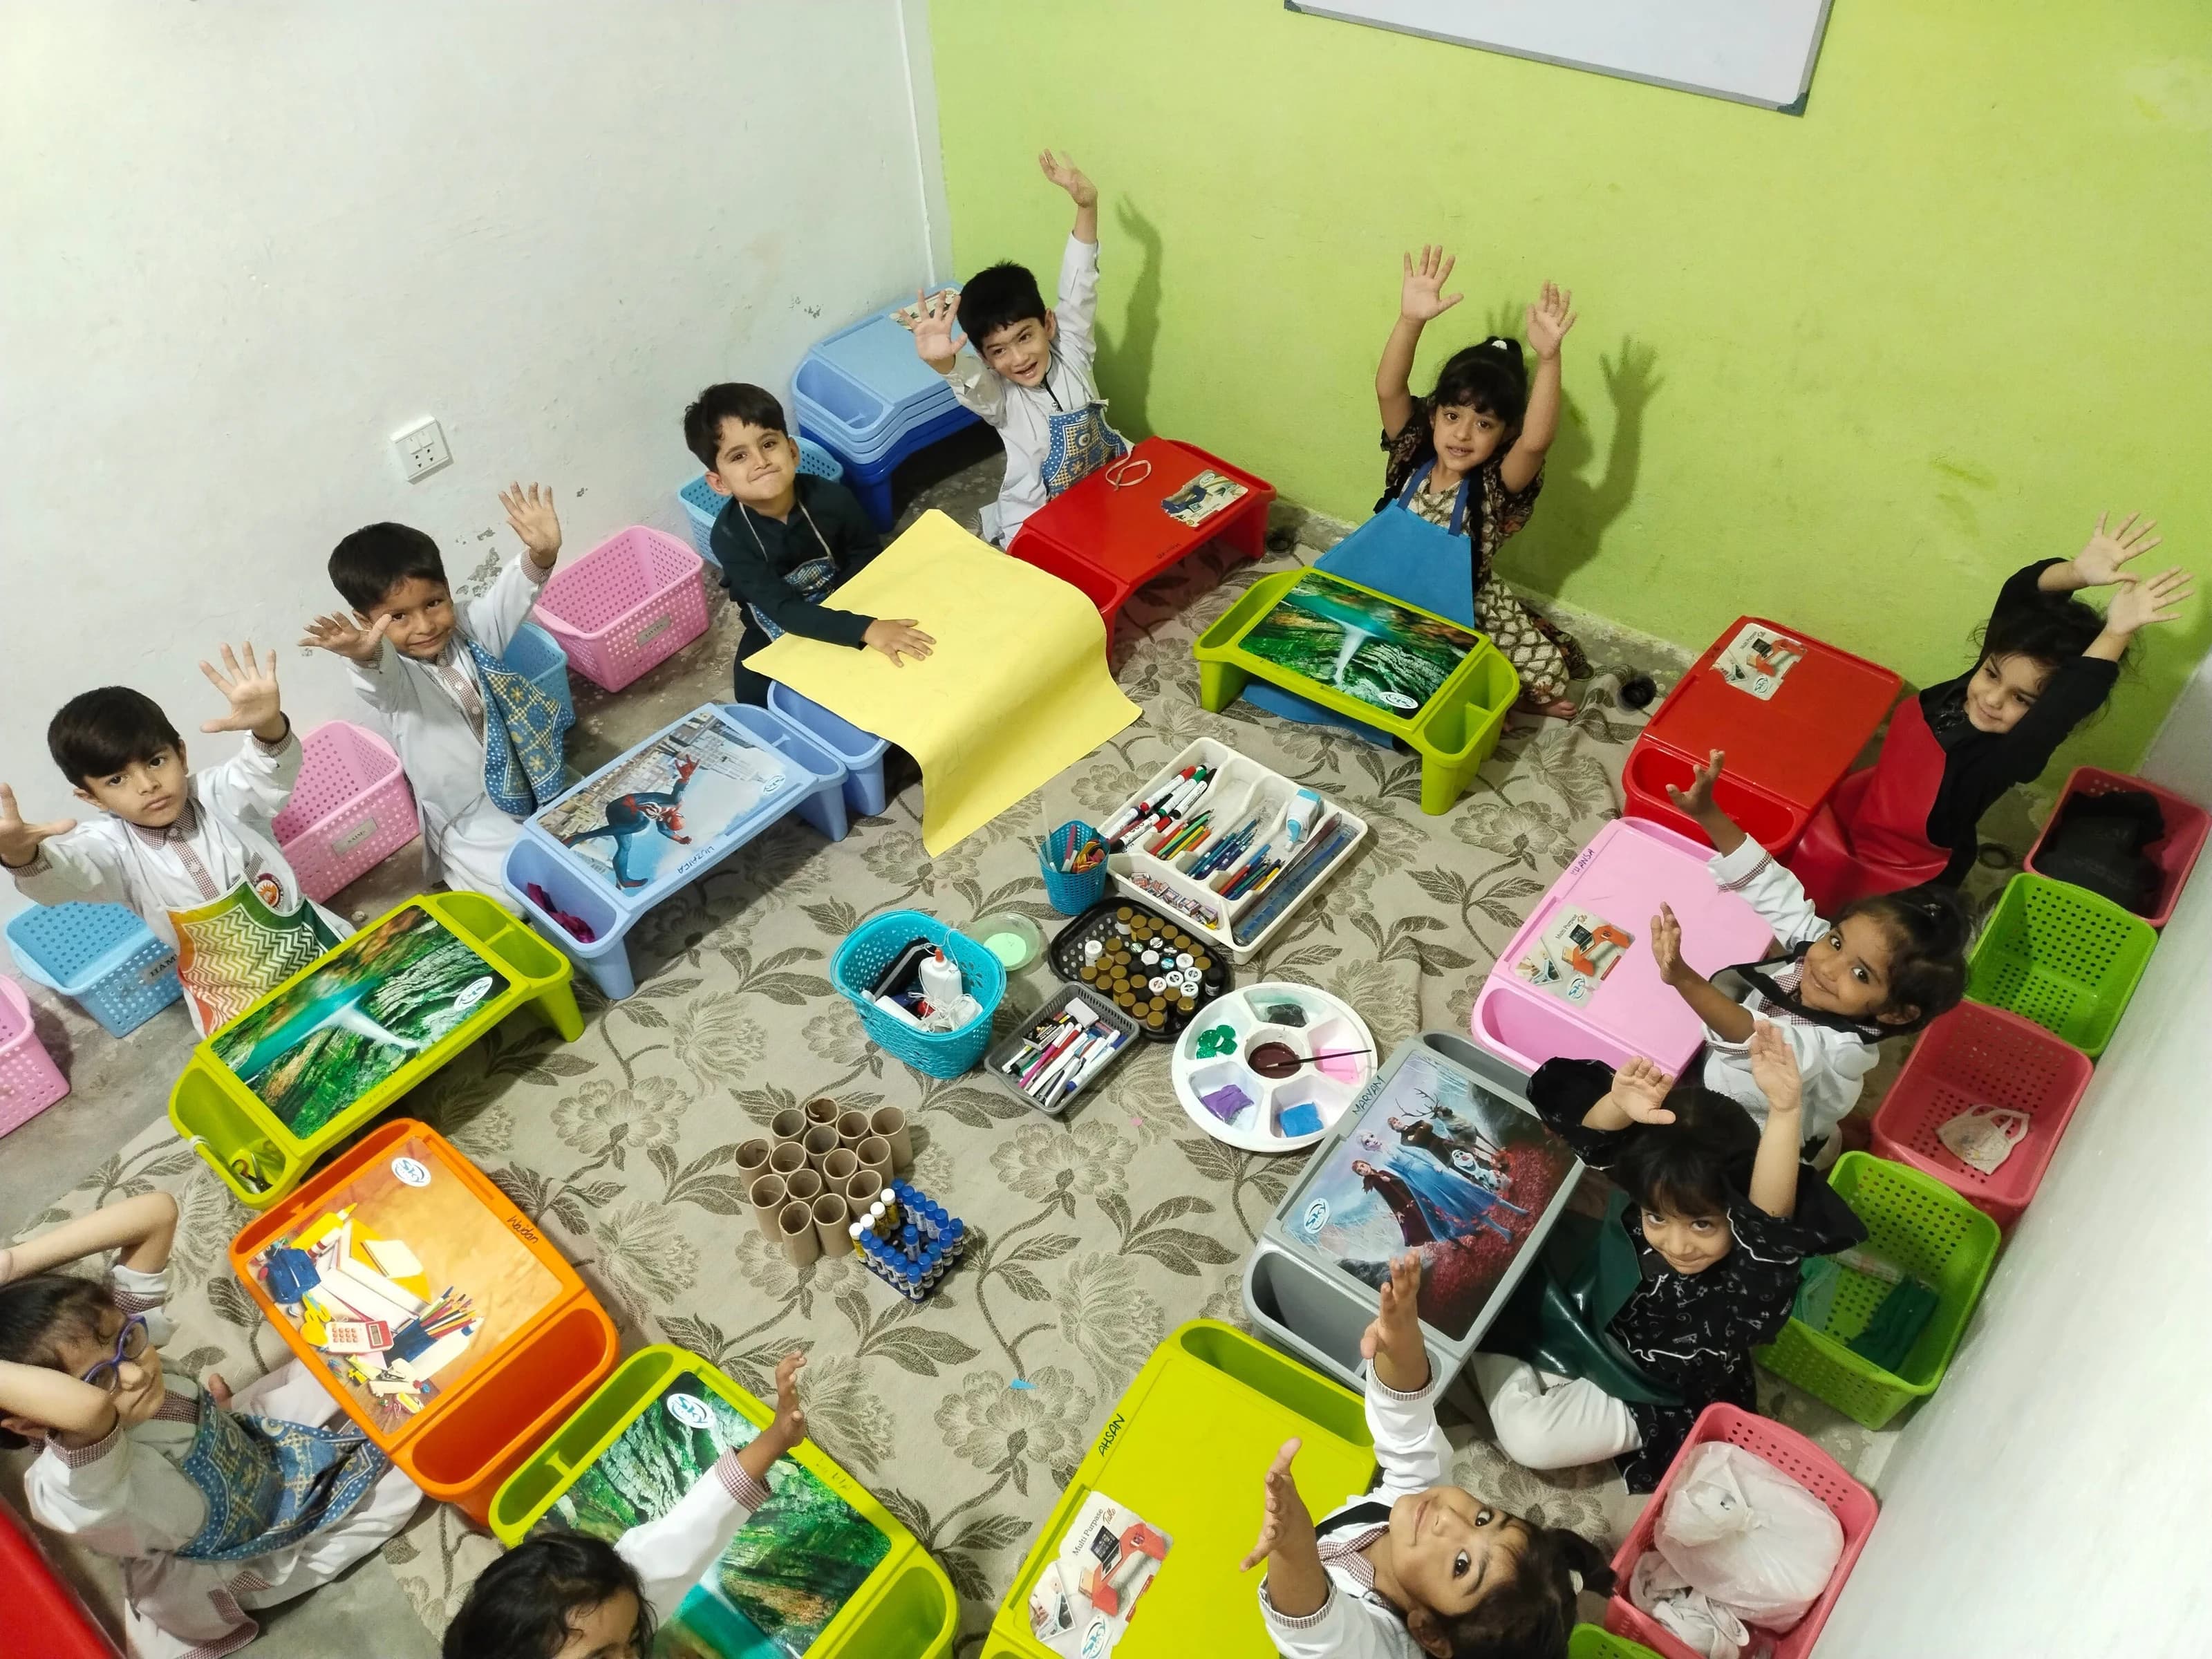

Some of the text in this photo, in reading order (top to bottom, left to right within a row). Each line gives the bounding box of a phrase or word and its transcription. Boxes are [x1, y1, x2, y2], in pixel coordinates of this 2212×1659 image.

[149, 954, 178, 977] HAM
[1351, 1075, 1387, 1114] MARYAM
[1098, 1413, 1125, 1457] AHSAN
[1072, 1535, 1087, 1556] Multi
